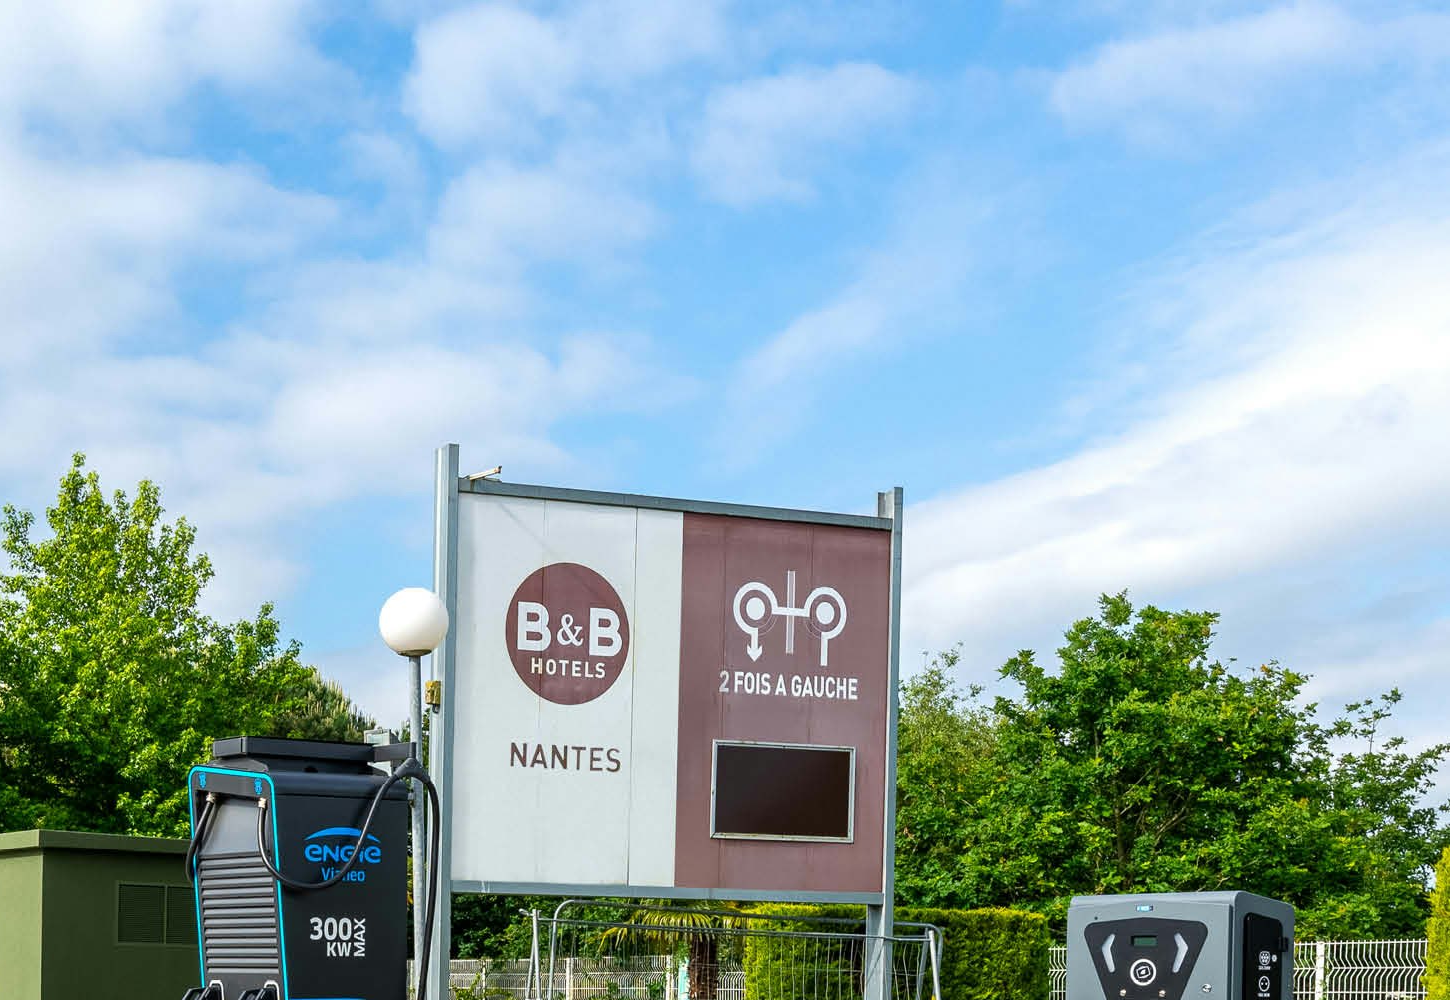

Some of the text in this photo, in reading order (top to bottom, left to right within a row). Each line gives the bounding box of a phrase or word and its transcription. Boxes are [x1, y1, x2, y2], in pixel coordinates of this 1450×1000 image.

[517, 600, 623, 657] B&B
[531, 657, 606, 679] HOTELS
[719, 670, 858, 700] 2 FOIS A GAUCHE
[510, 742, 621, 772] NANTES
[321, 866, 366, 882] Vineo
[310, 917, 352, 941] 300
[353, 918, 366, 957] MAX
[326, 941, 352, 957] KW
